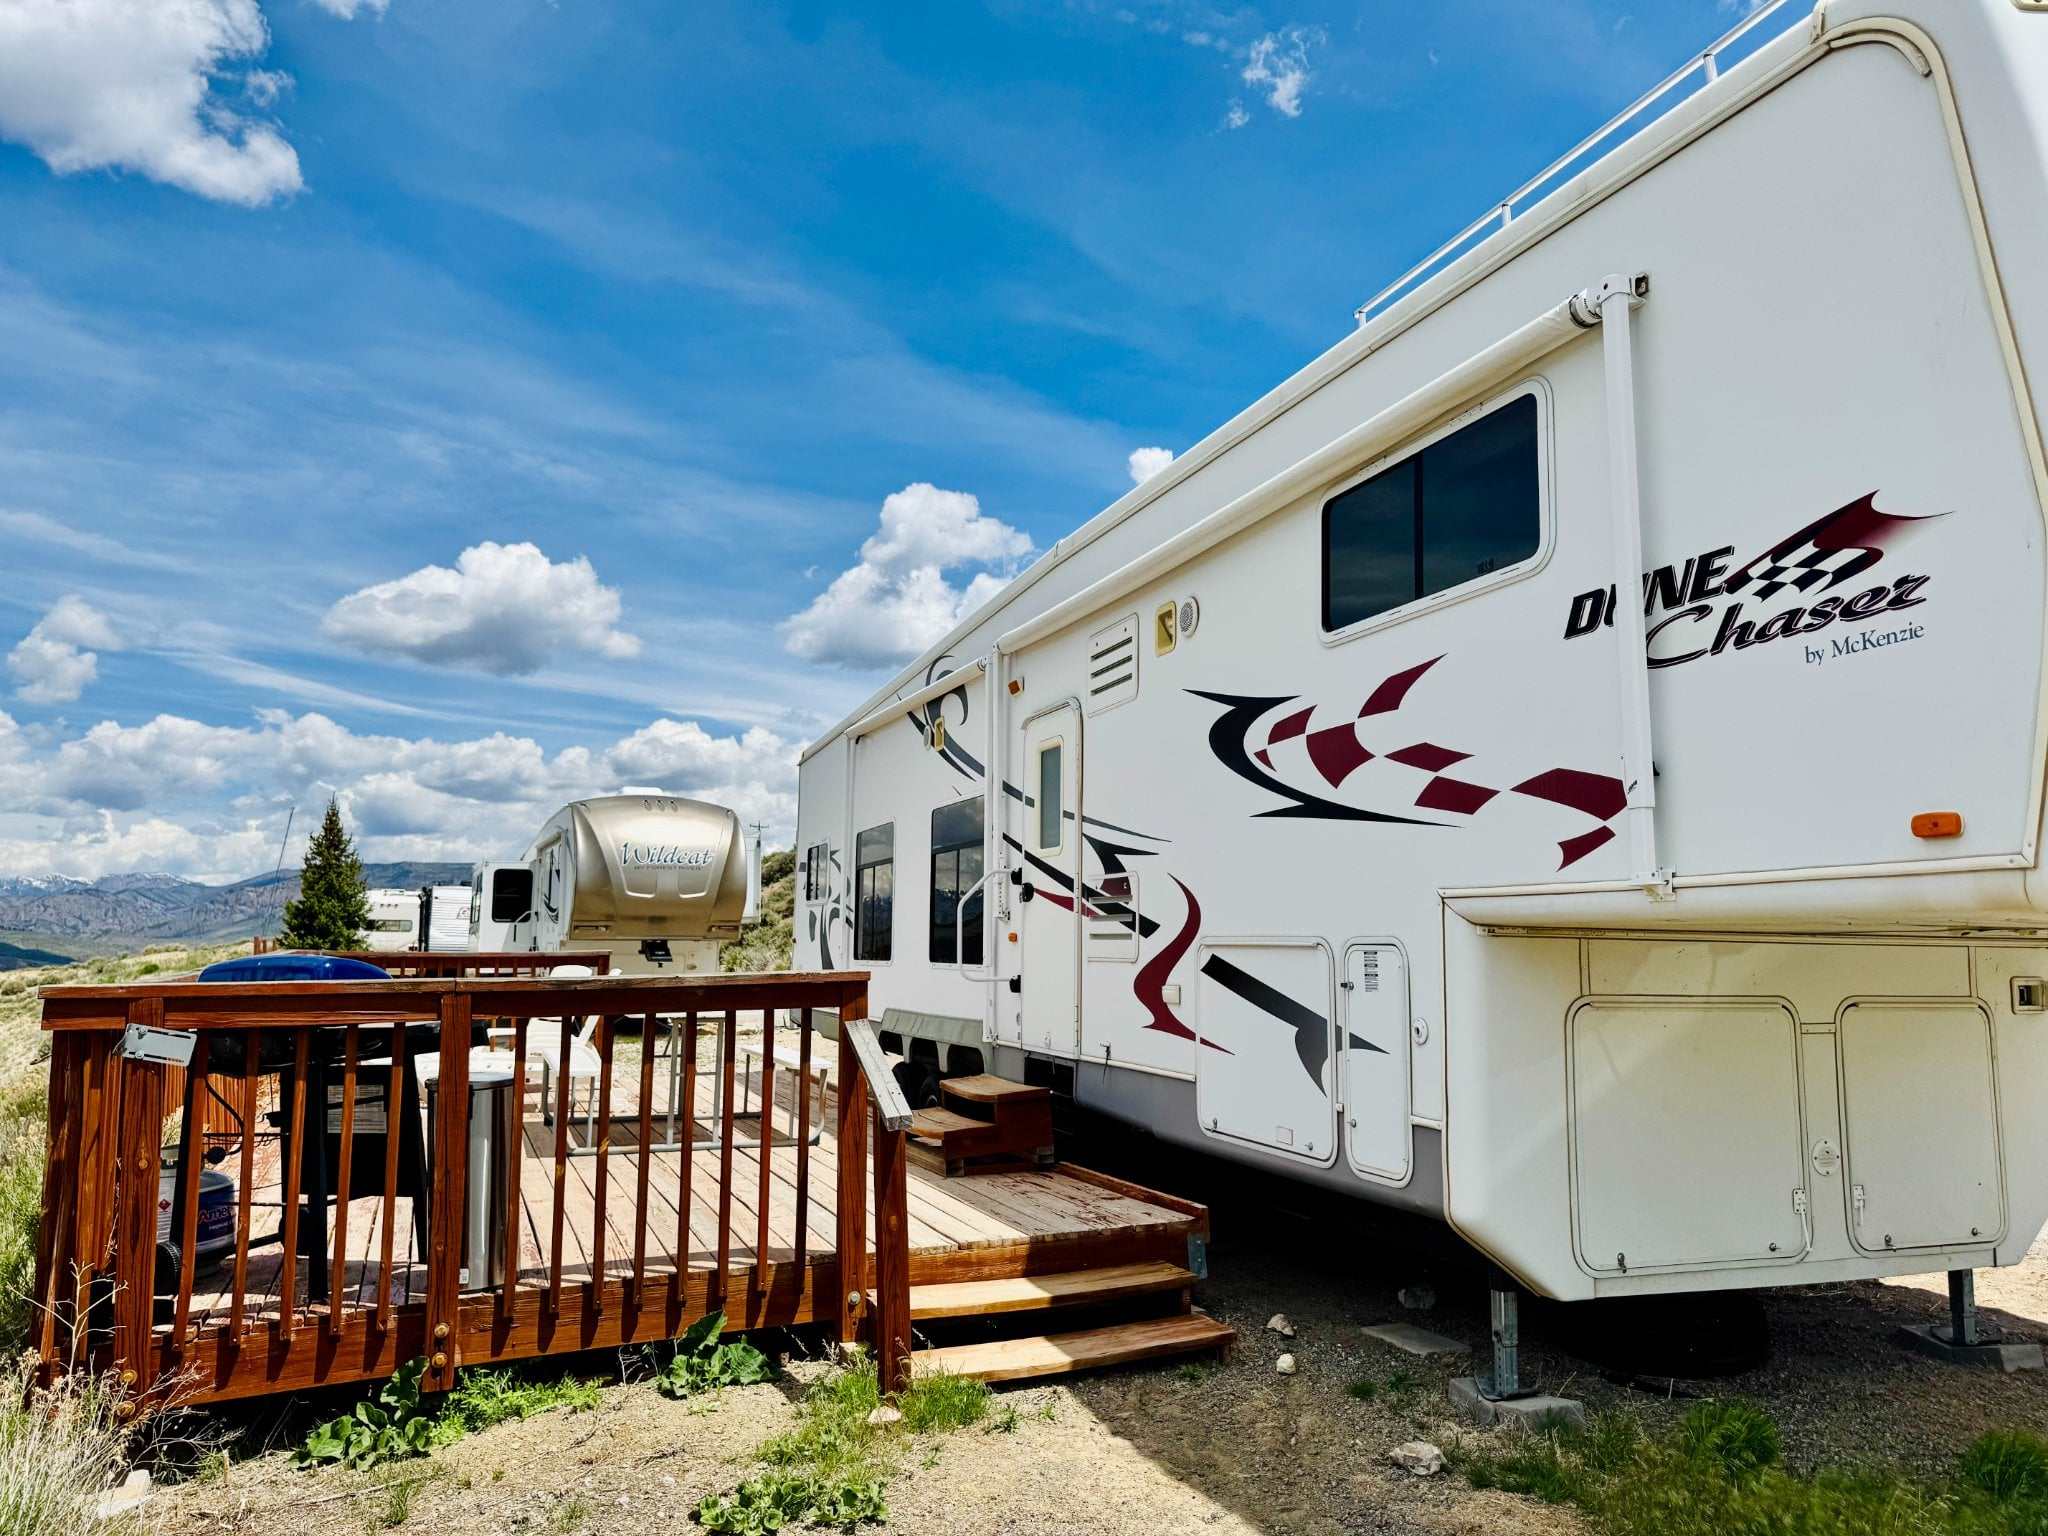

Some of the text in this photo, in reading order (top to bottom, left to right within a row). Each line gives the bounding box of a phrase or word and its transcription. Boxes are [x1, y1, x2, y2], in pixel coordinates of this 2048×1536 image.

[1646, 573, 1931, 670] Chaser
[1804, 620, 1925, 666] by McKenzie
[622, 841, 714, 866] Wildcat
